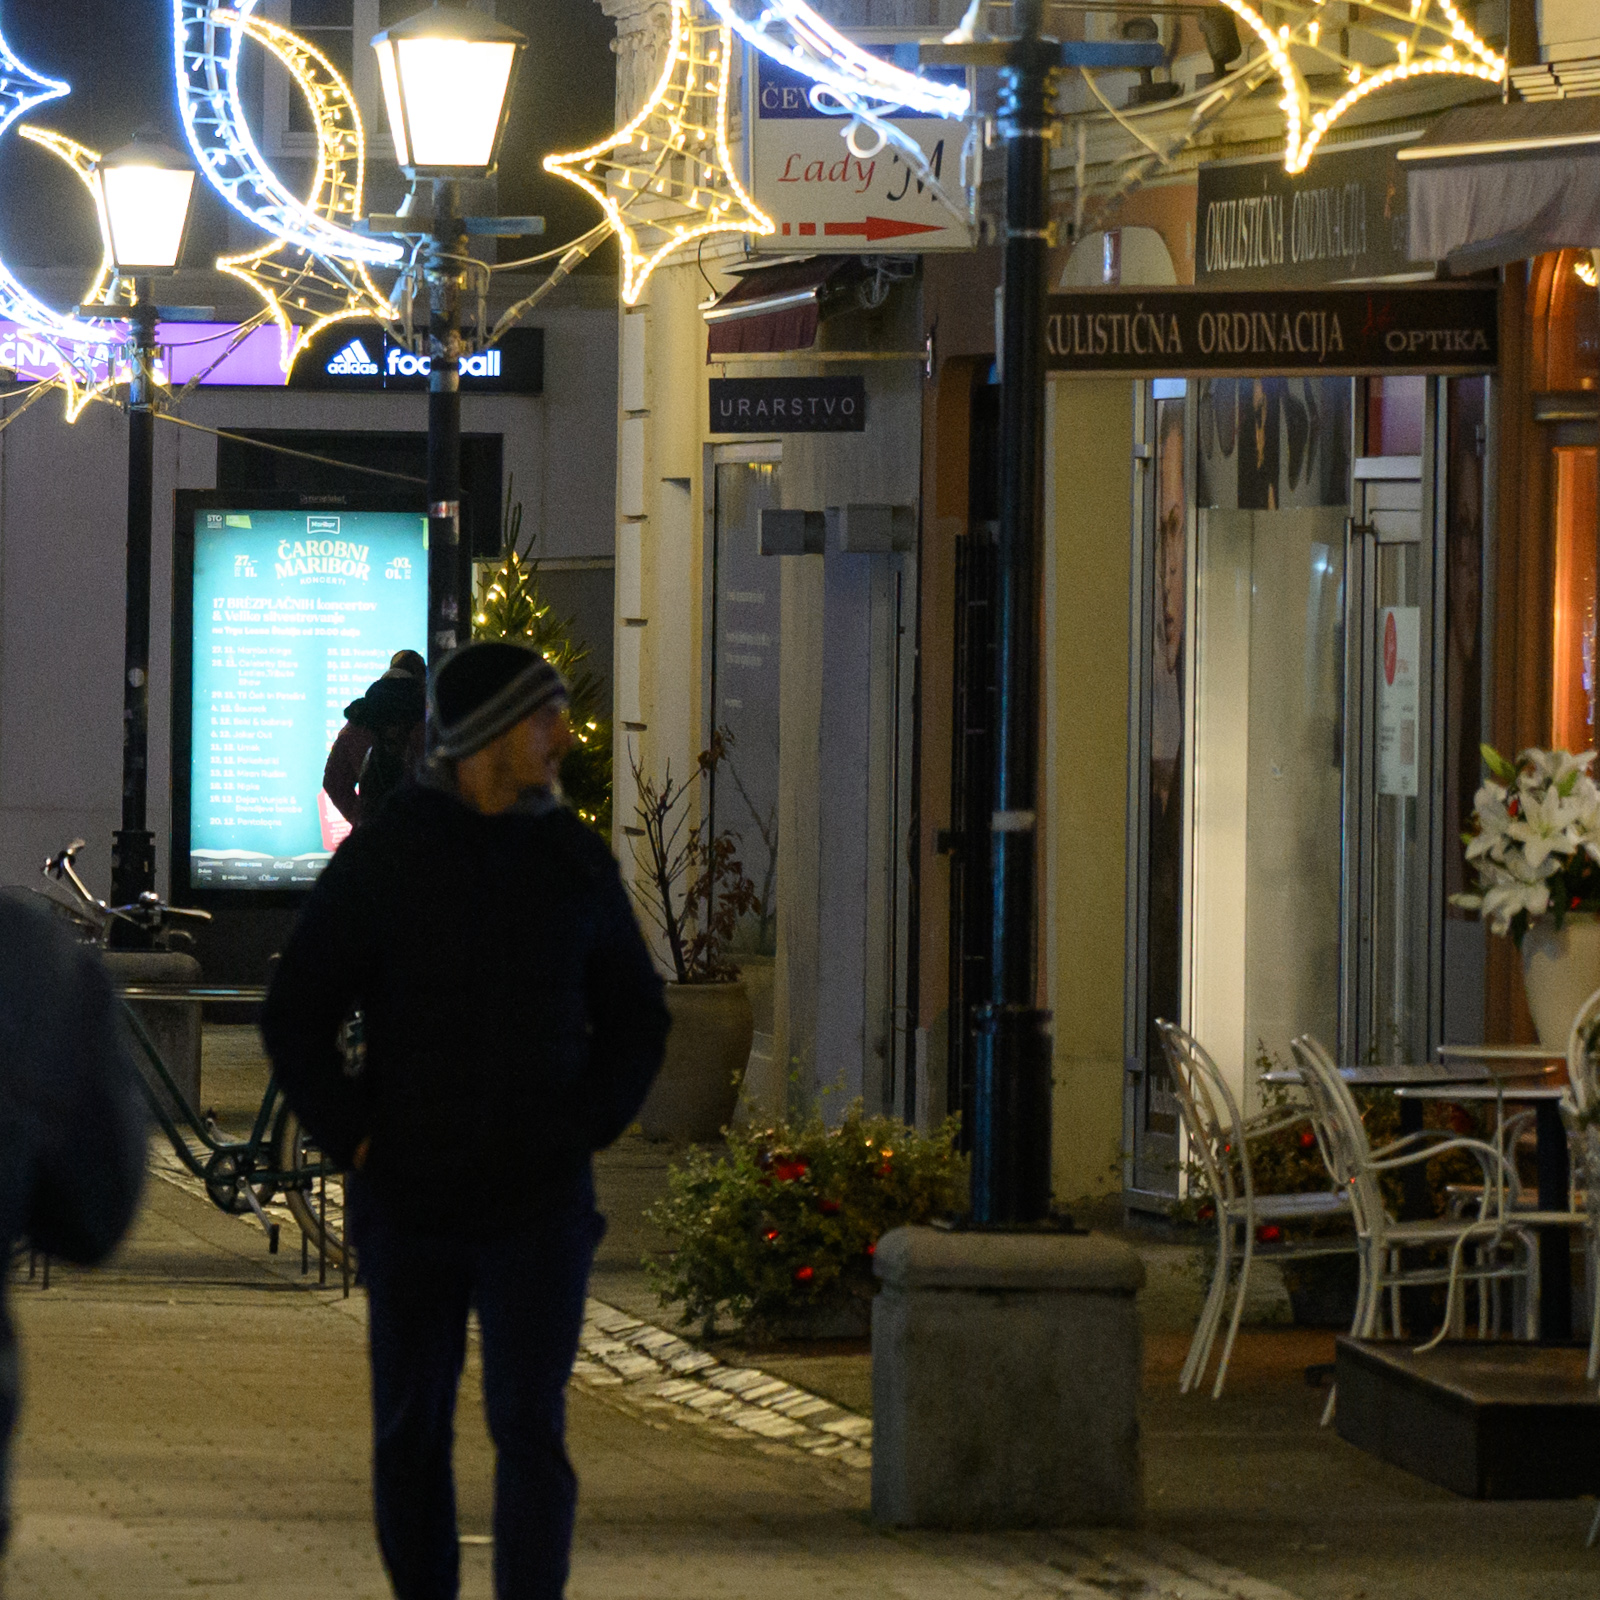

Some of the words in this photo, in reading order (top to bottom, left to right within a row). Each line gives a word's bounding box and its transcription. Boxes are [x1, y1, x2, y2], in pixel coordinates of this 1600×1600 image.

[777, 152, 877, 194] Lady
[886, 138, 945, 202] M
[1045, 302, 1184, 356] KULISTIČNA
[1198, 311, 1344, 363] ORDINACIJA
[1384, 329, 1491, 352] OPTIKA
[327, 361, 379, 375] adidas
[387, 348, 501, 377] fooall
[720, 397, 856, 417] URARSTVO
[277, 539, 370, 563] ČAROBNI
[274, 557, 371, 581] MARIBOR
